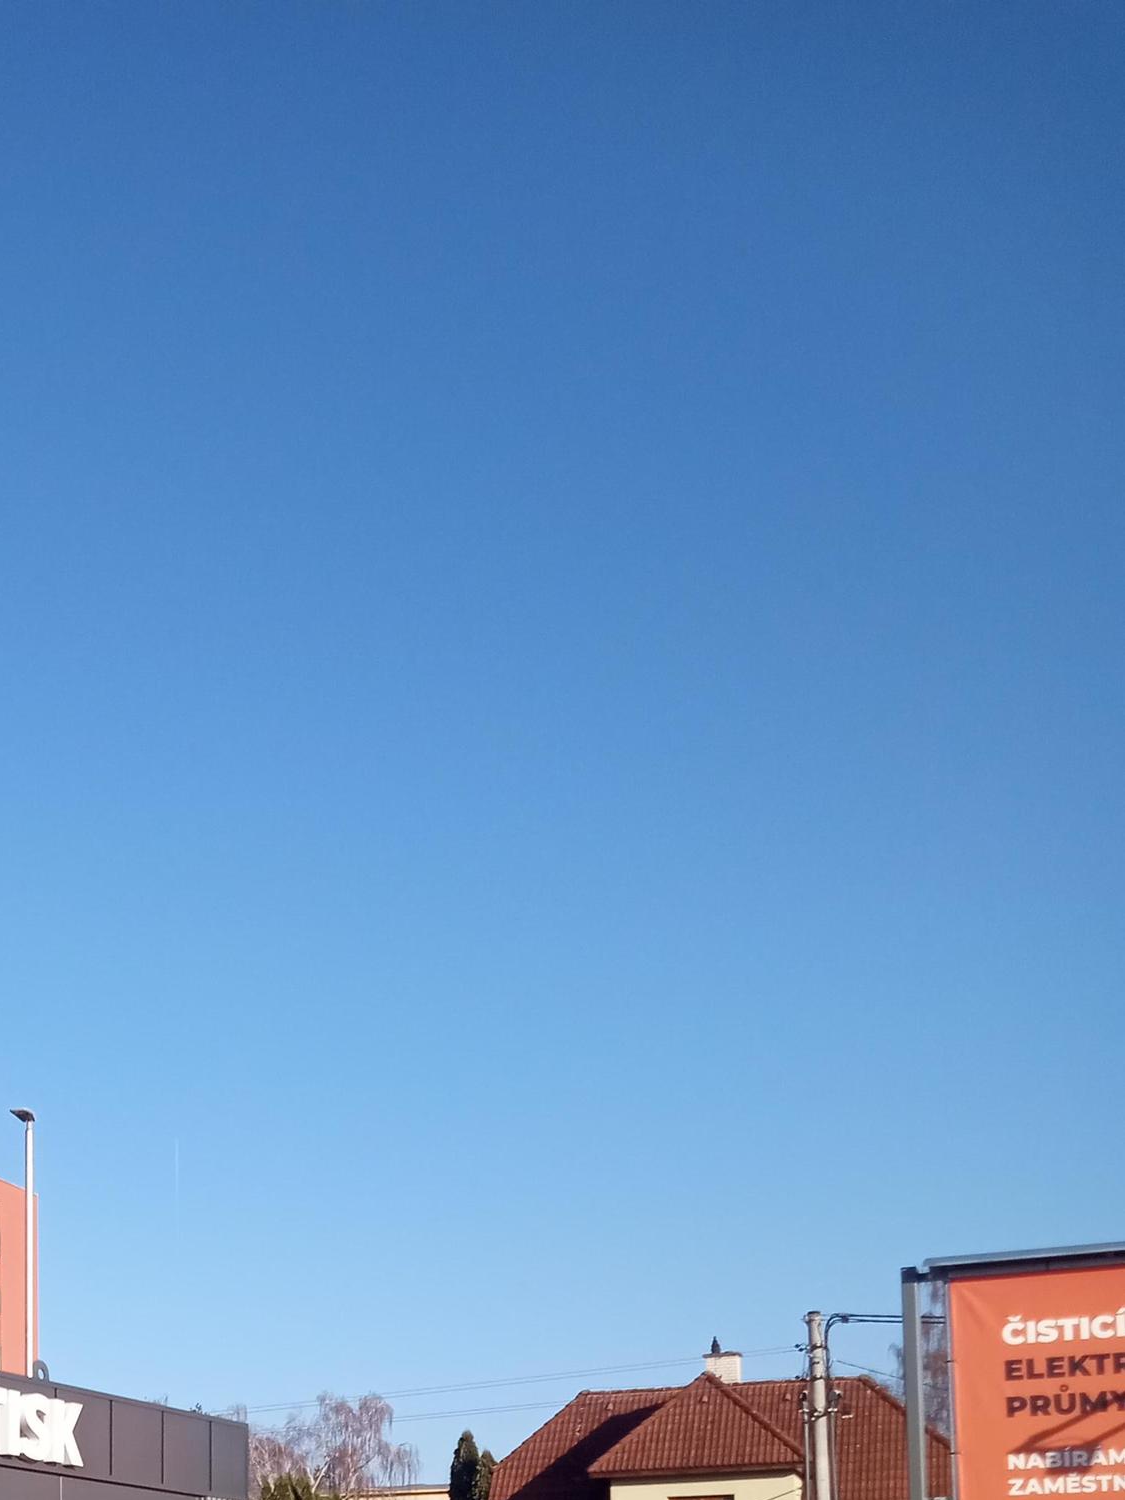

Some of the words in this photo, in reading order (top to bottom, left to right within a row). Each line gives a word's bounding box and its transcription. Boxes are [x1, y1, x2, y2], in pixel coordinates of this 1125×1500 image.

[1002, 1307, 1125, 1345] ČISTICÍ
[1005, 1352, 1125, 1381] ELEKTR
[1008, 1445, 1125, 1470] NABÍRÁM
